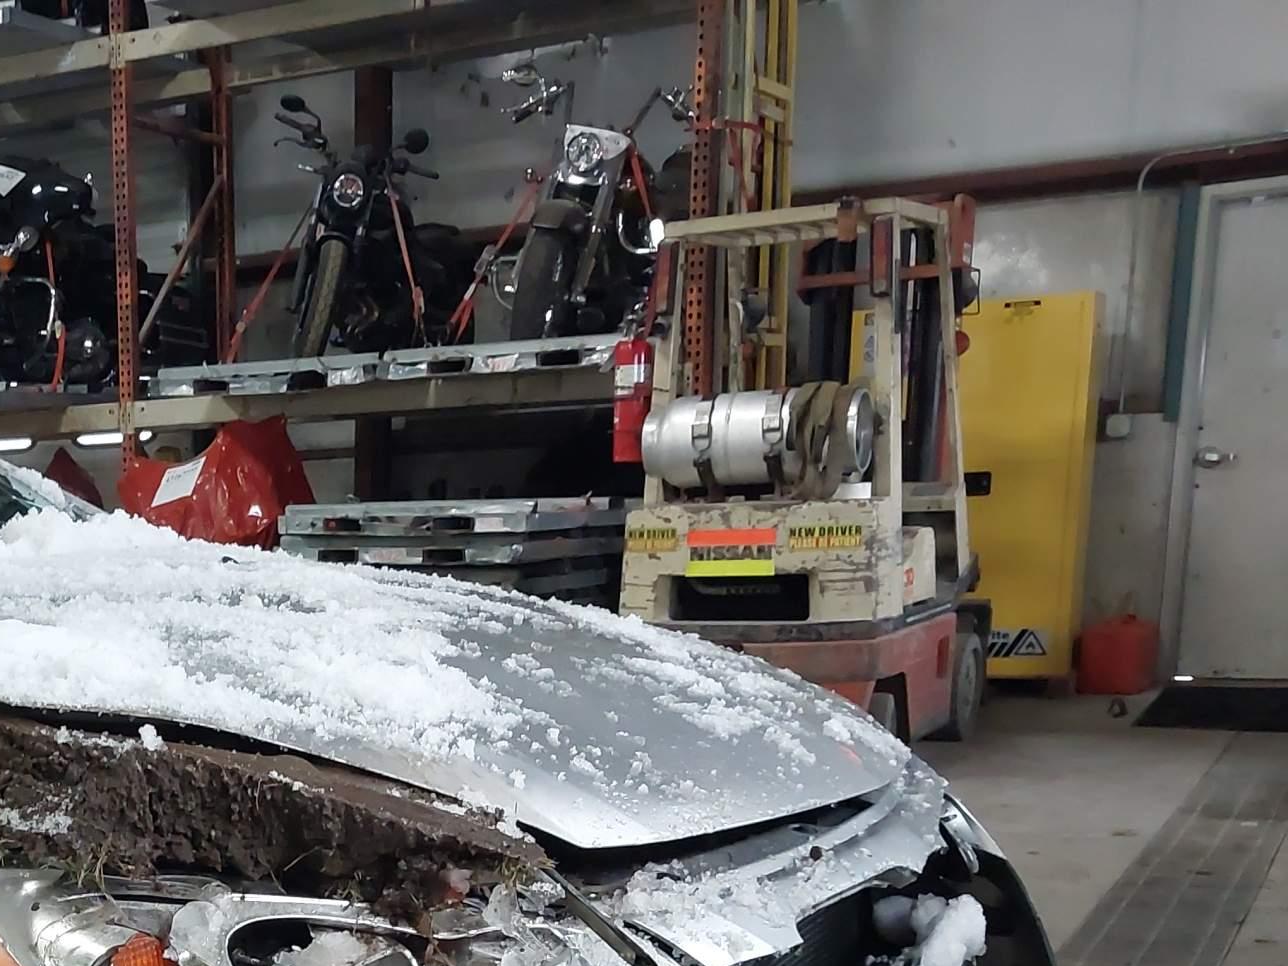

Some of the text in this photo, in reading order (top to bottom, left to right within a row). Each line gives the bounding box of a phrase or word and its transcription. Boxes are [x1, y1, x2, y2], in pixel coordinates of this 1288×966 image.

[789, 525, 862, 537] NEW DRIVER
[689, 545, 773, 561] NISSAN
